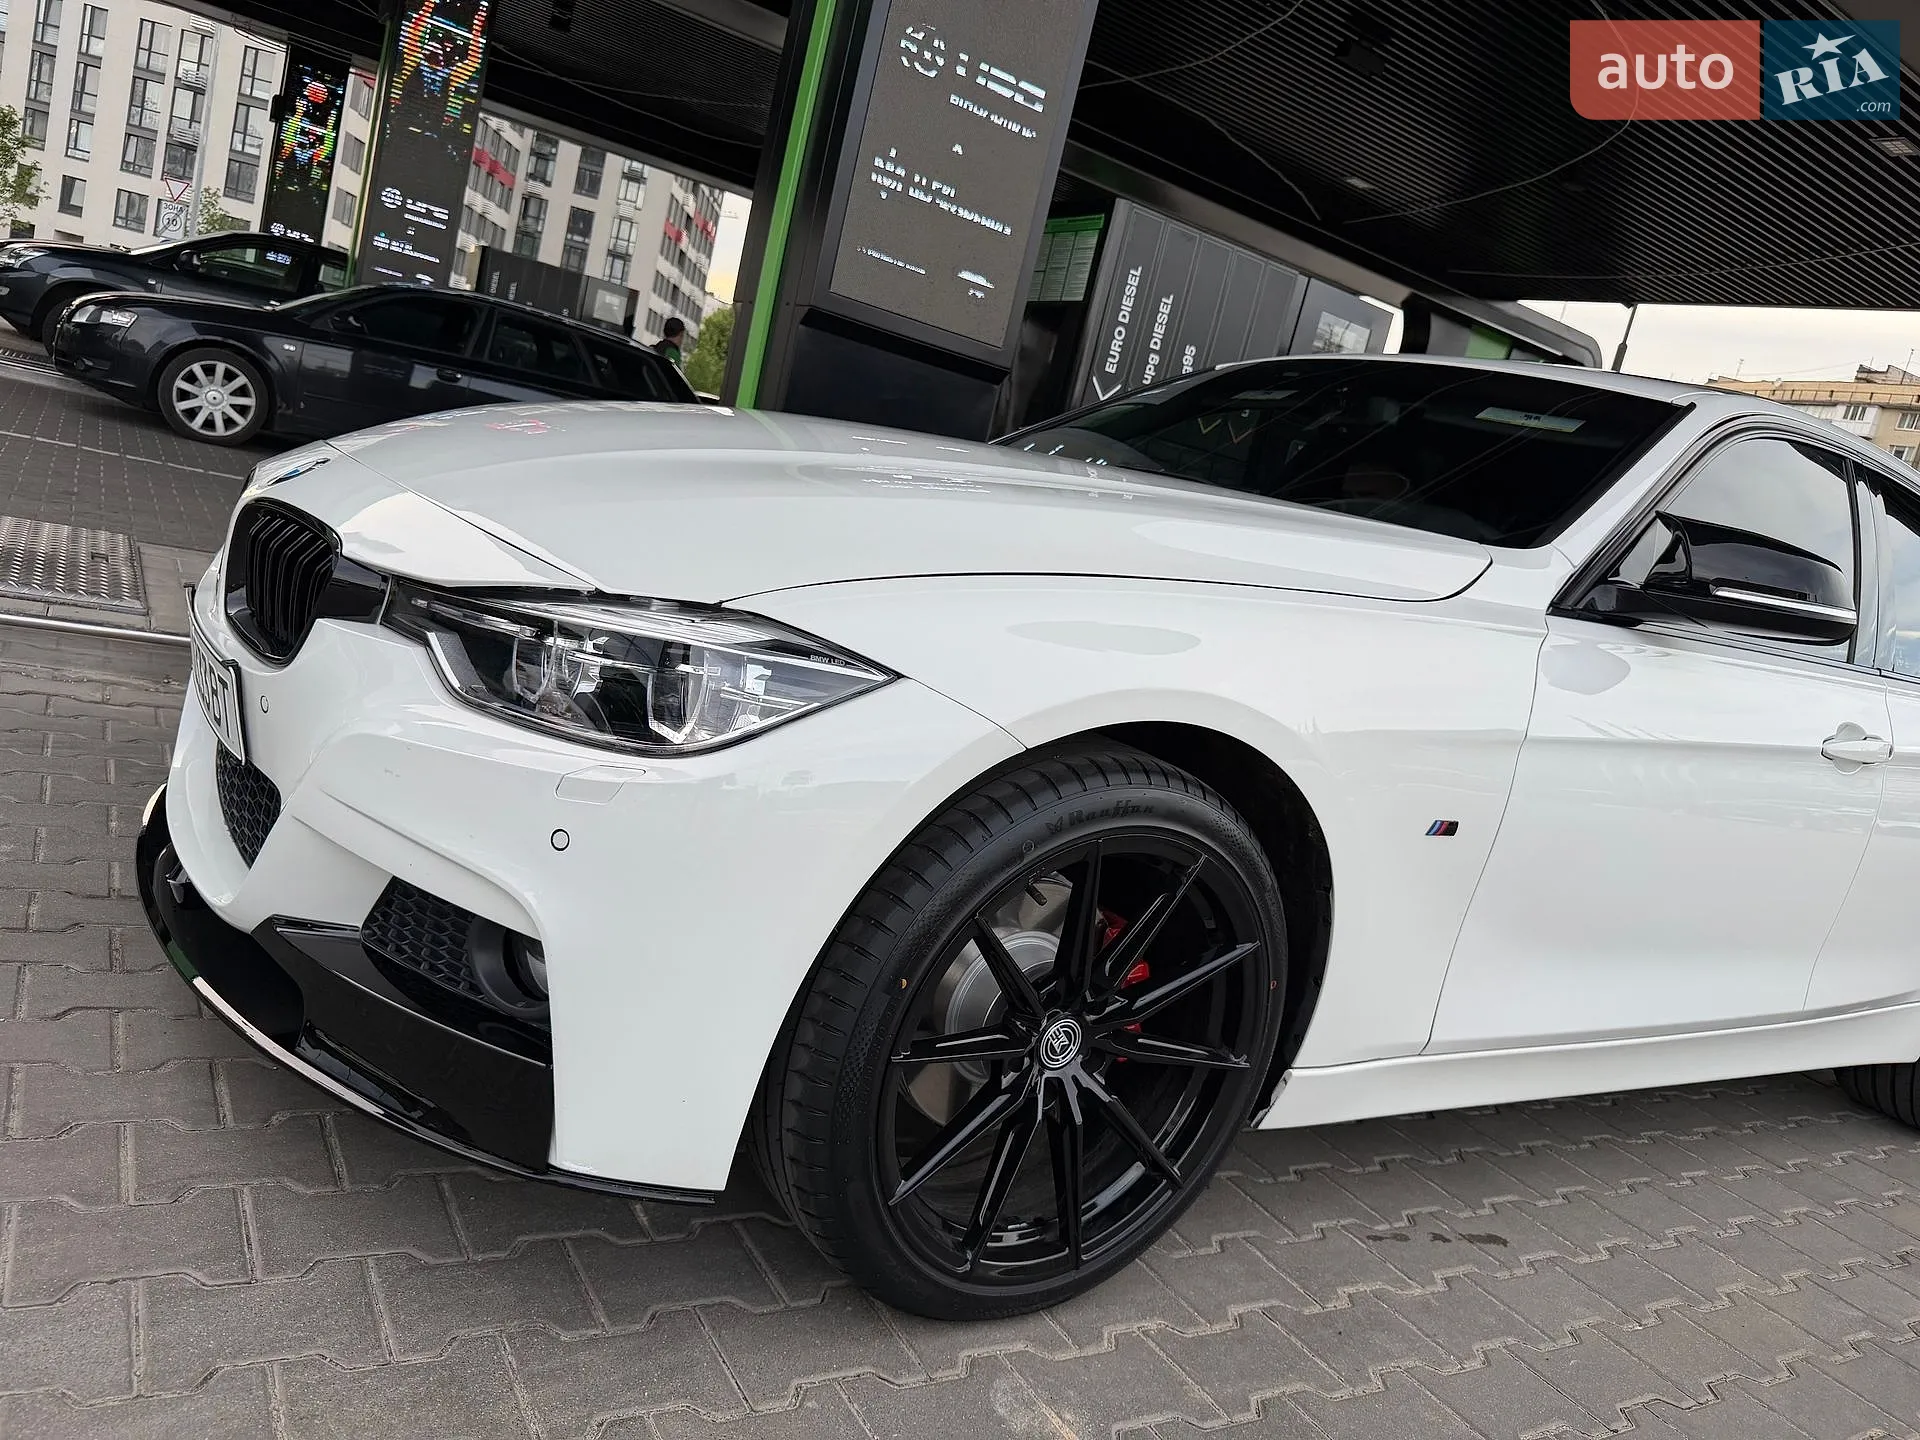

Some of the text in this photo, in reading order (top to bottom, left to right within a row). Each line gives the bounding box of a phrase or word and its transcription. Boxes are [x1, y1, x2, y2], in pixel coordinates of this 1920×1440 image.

[1104, 265, 1142, 374] EURO DIESEL
[1142, 293, 1174, 385] upg DIESEL
[810, 654, 846, 667] BMW LED
